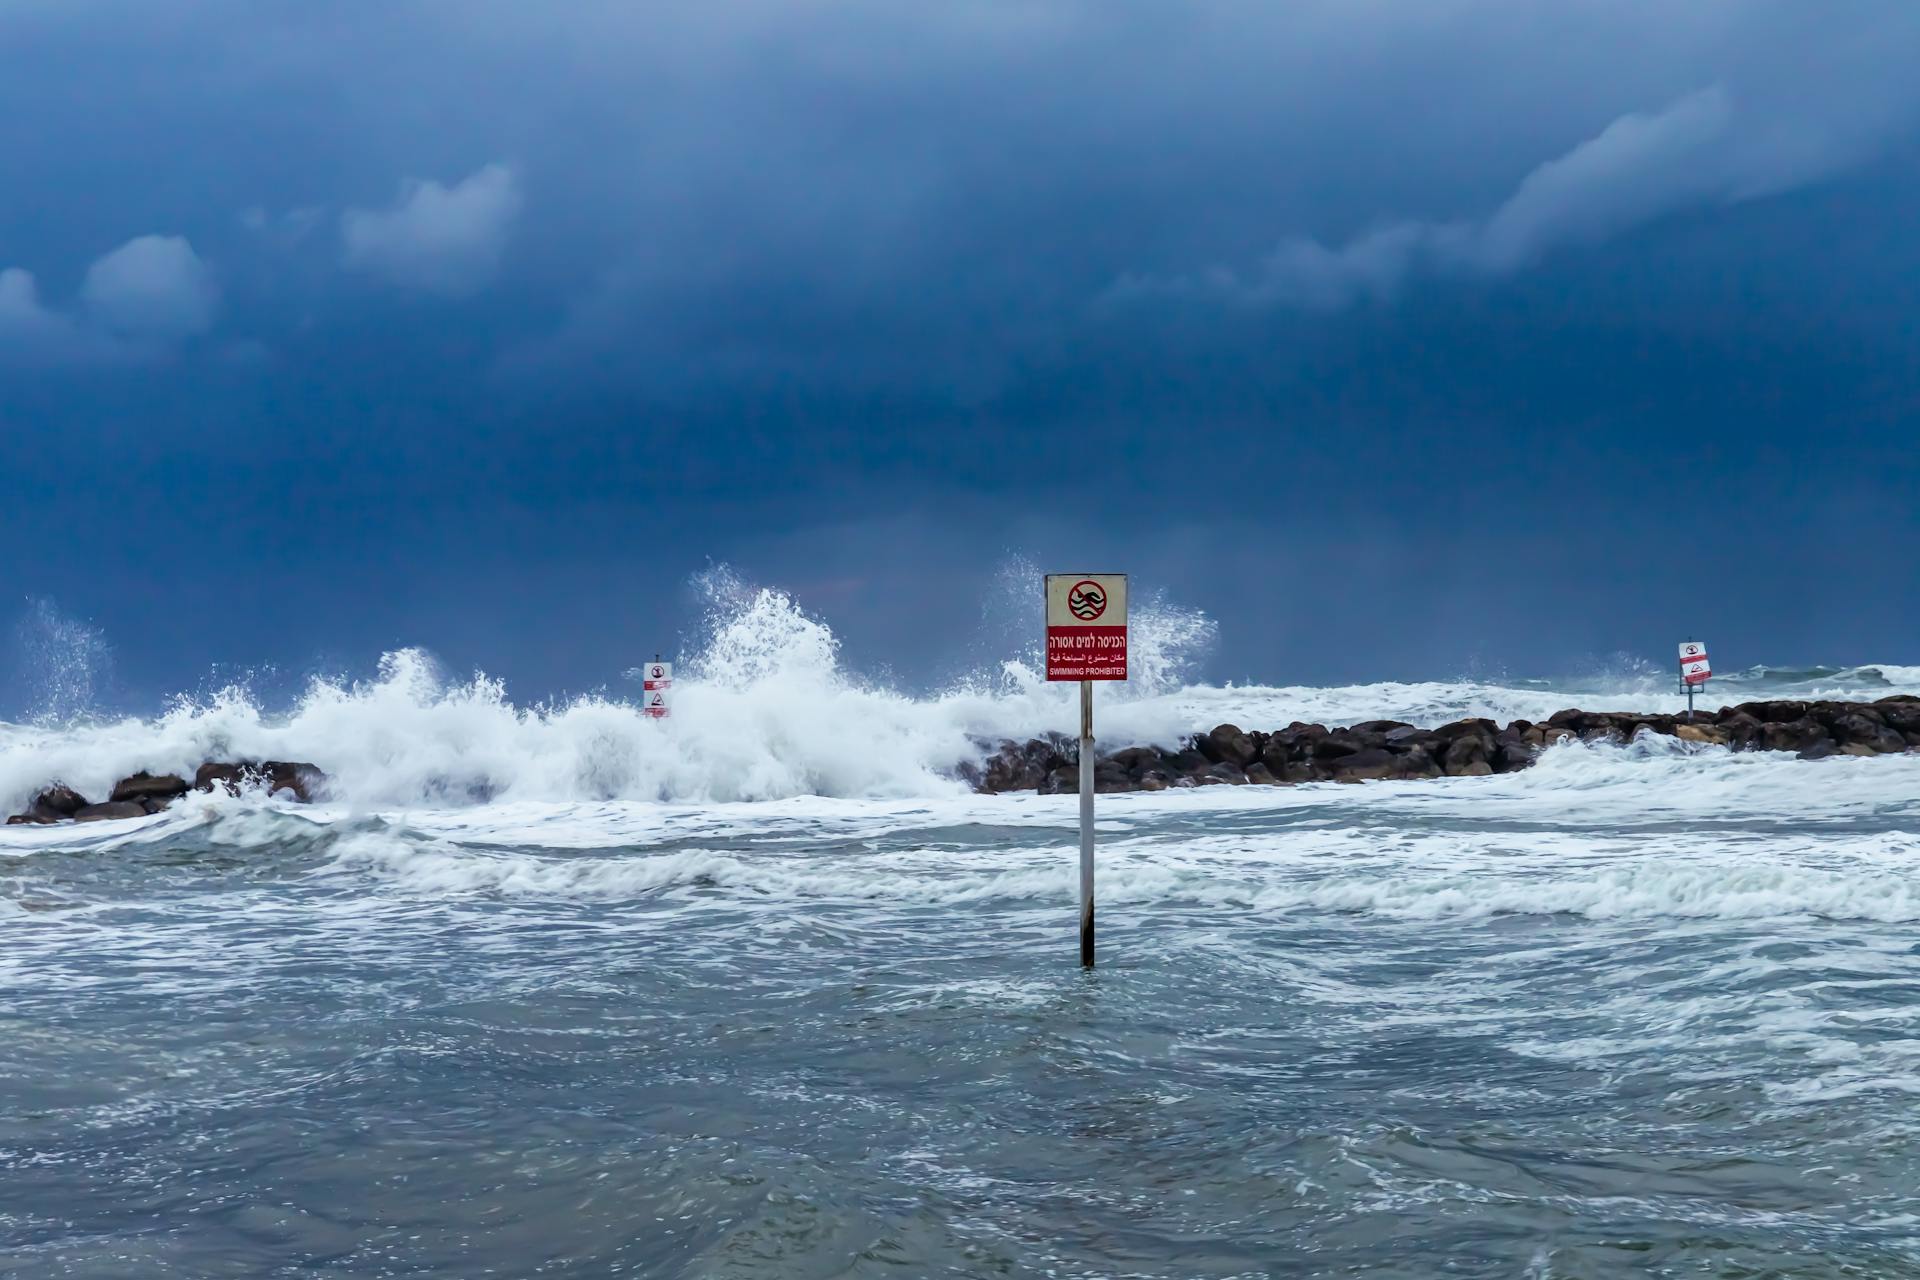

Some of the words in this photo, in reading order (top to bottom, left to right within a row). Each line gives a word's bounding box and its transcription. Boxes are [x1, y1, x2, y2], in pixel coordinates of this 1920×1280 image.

[1050, 636, 1074, 648] אסורה
[1076, 632, 1095, 648] למים
[1098, 636, 1126, 648] הכניסה
[1088, 653, 1108, 664] ممنوع
[1110, 653, 1124, 662] مكان
